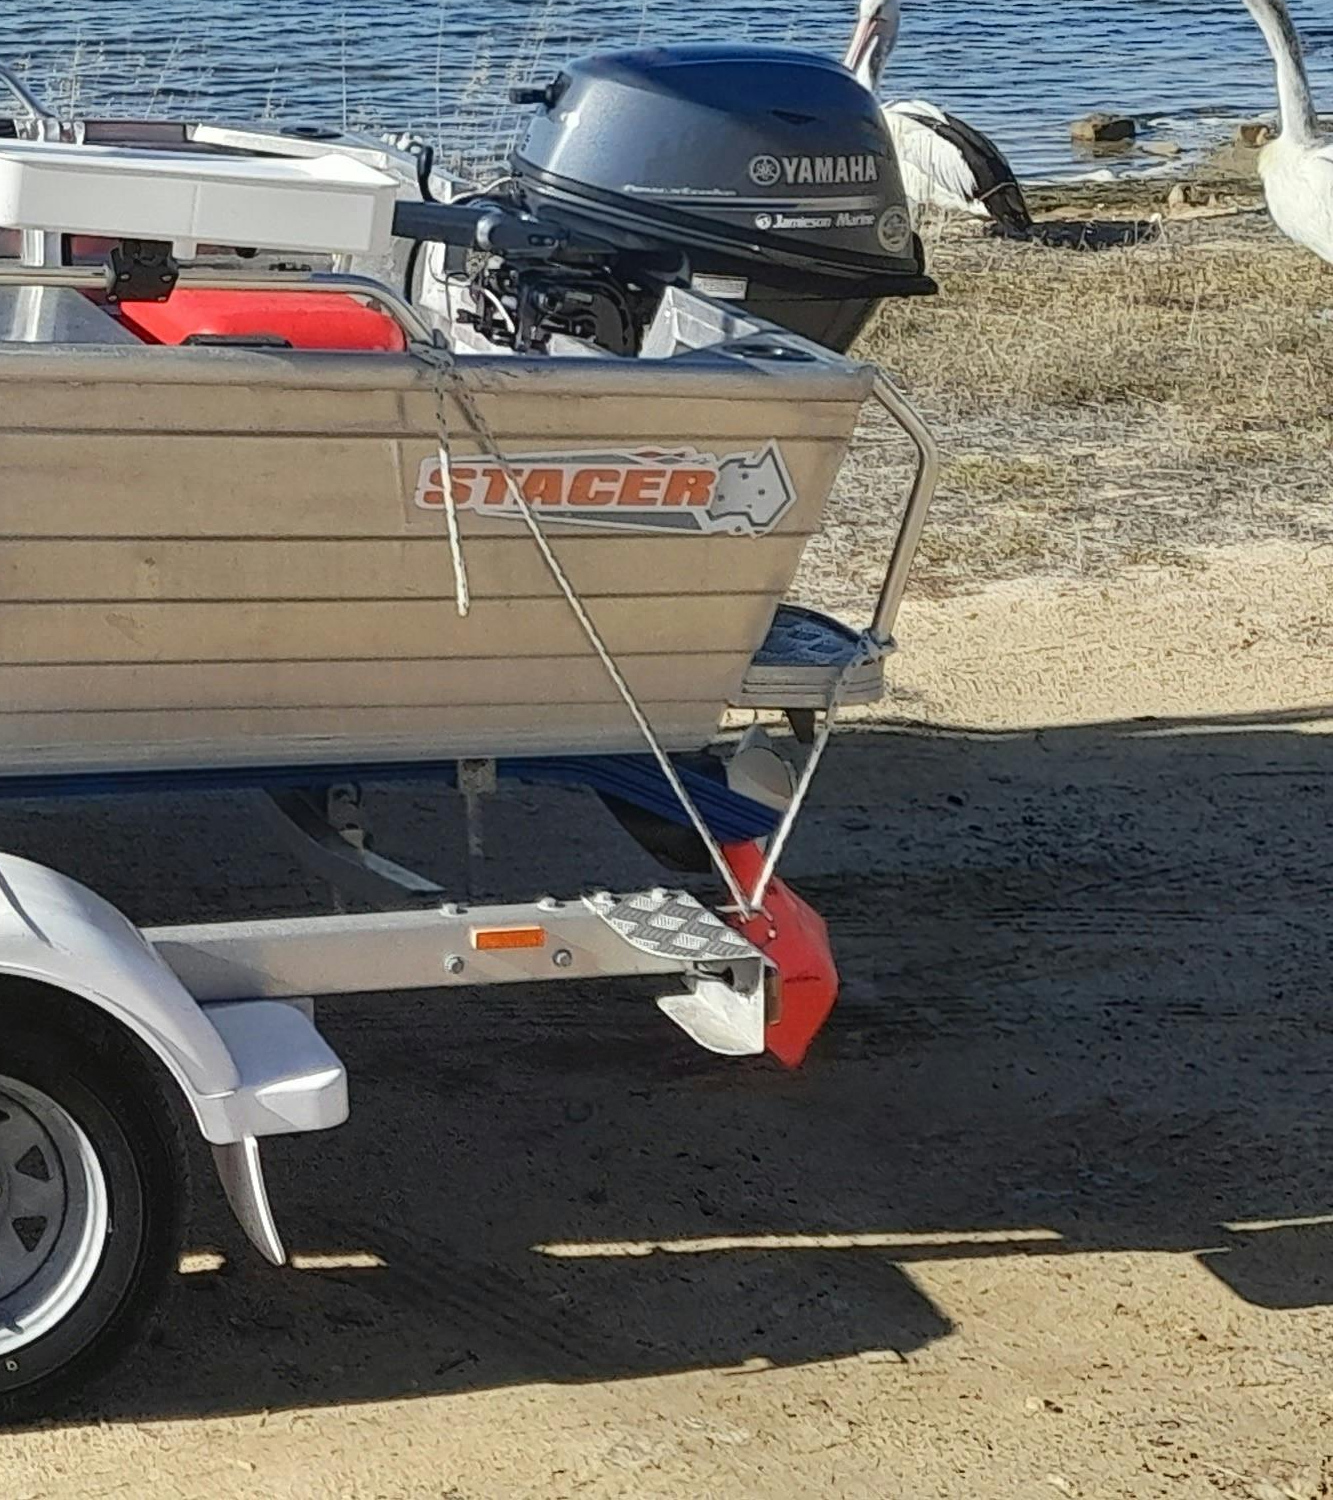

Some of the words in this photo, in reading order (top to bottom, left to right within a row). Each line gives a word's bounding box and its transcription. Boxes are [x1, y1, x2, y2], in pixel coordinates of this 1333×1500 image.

[781, 155, 878, 184] YAMAHA
[773, 214, 832, 228] Jamieson
[422, 467, 717, 507] STACER
